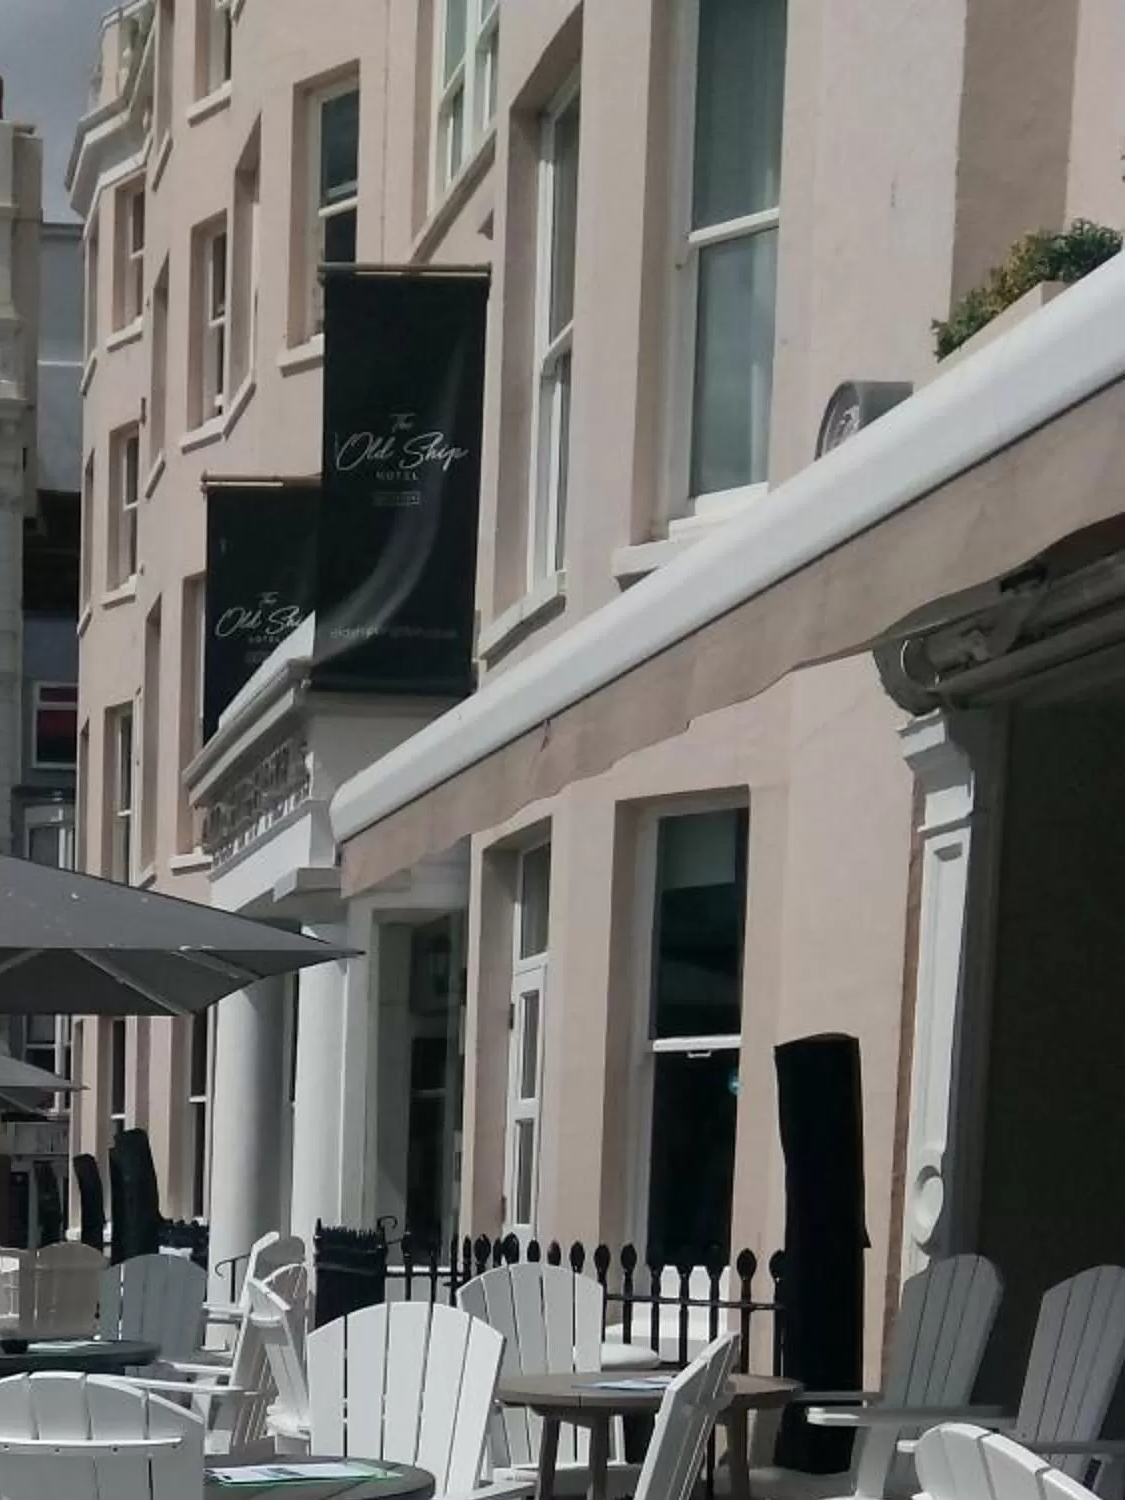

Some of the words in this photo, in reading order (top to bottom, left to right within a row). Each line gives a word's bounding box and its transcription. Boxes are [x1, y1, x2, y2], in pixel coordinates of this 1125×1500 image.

[335, 431, 395, 471] Old
[398, 431, 469, 471] Ship
[215, 607, 262, 637] Old
[265, 605, 303, 635] Shi
